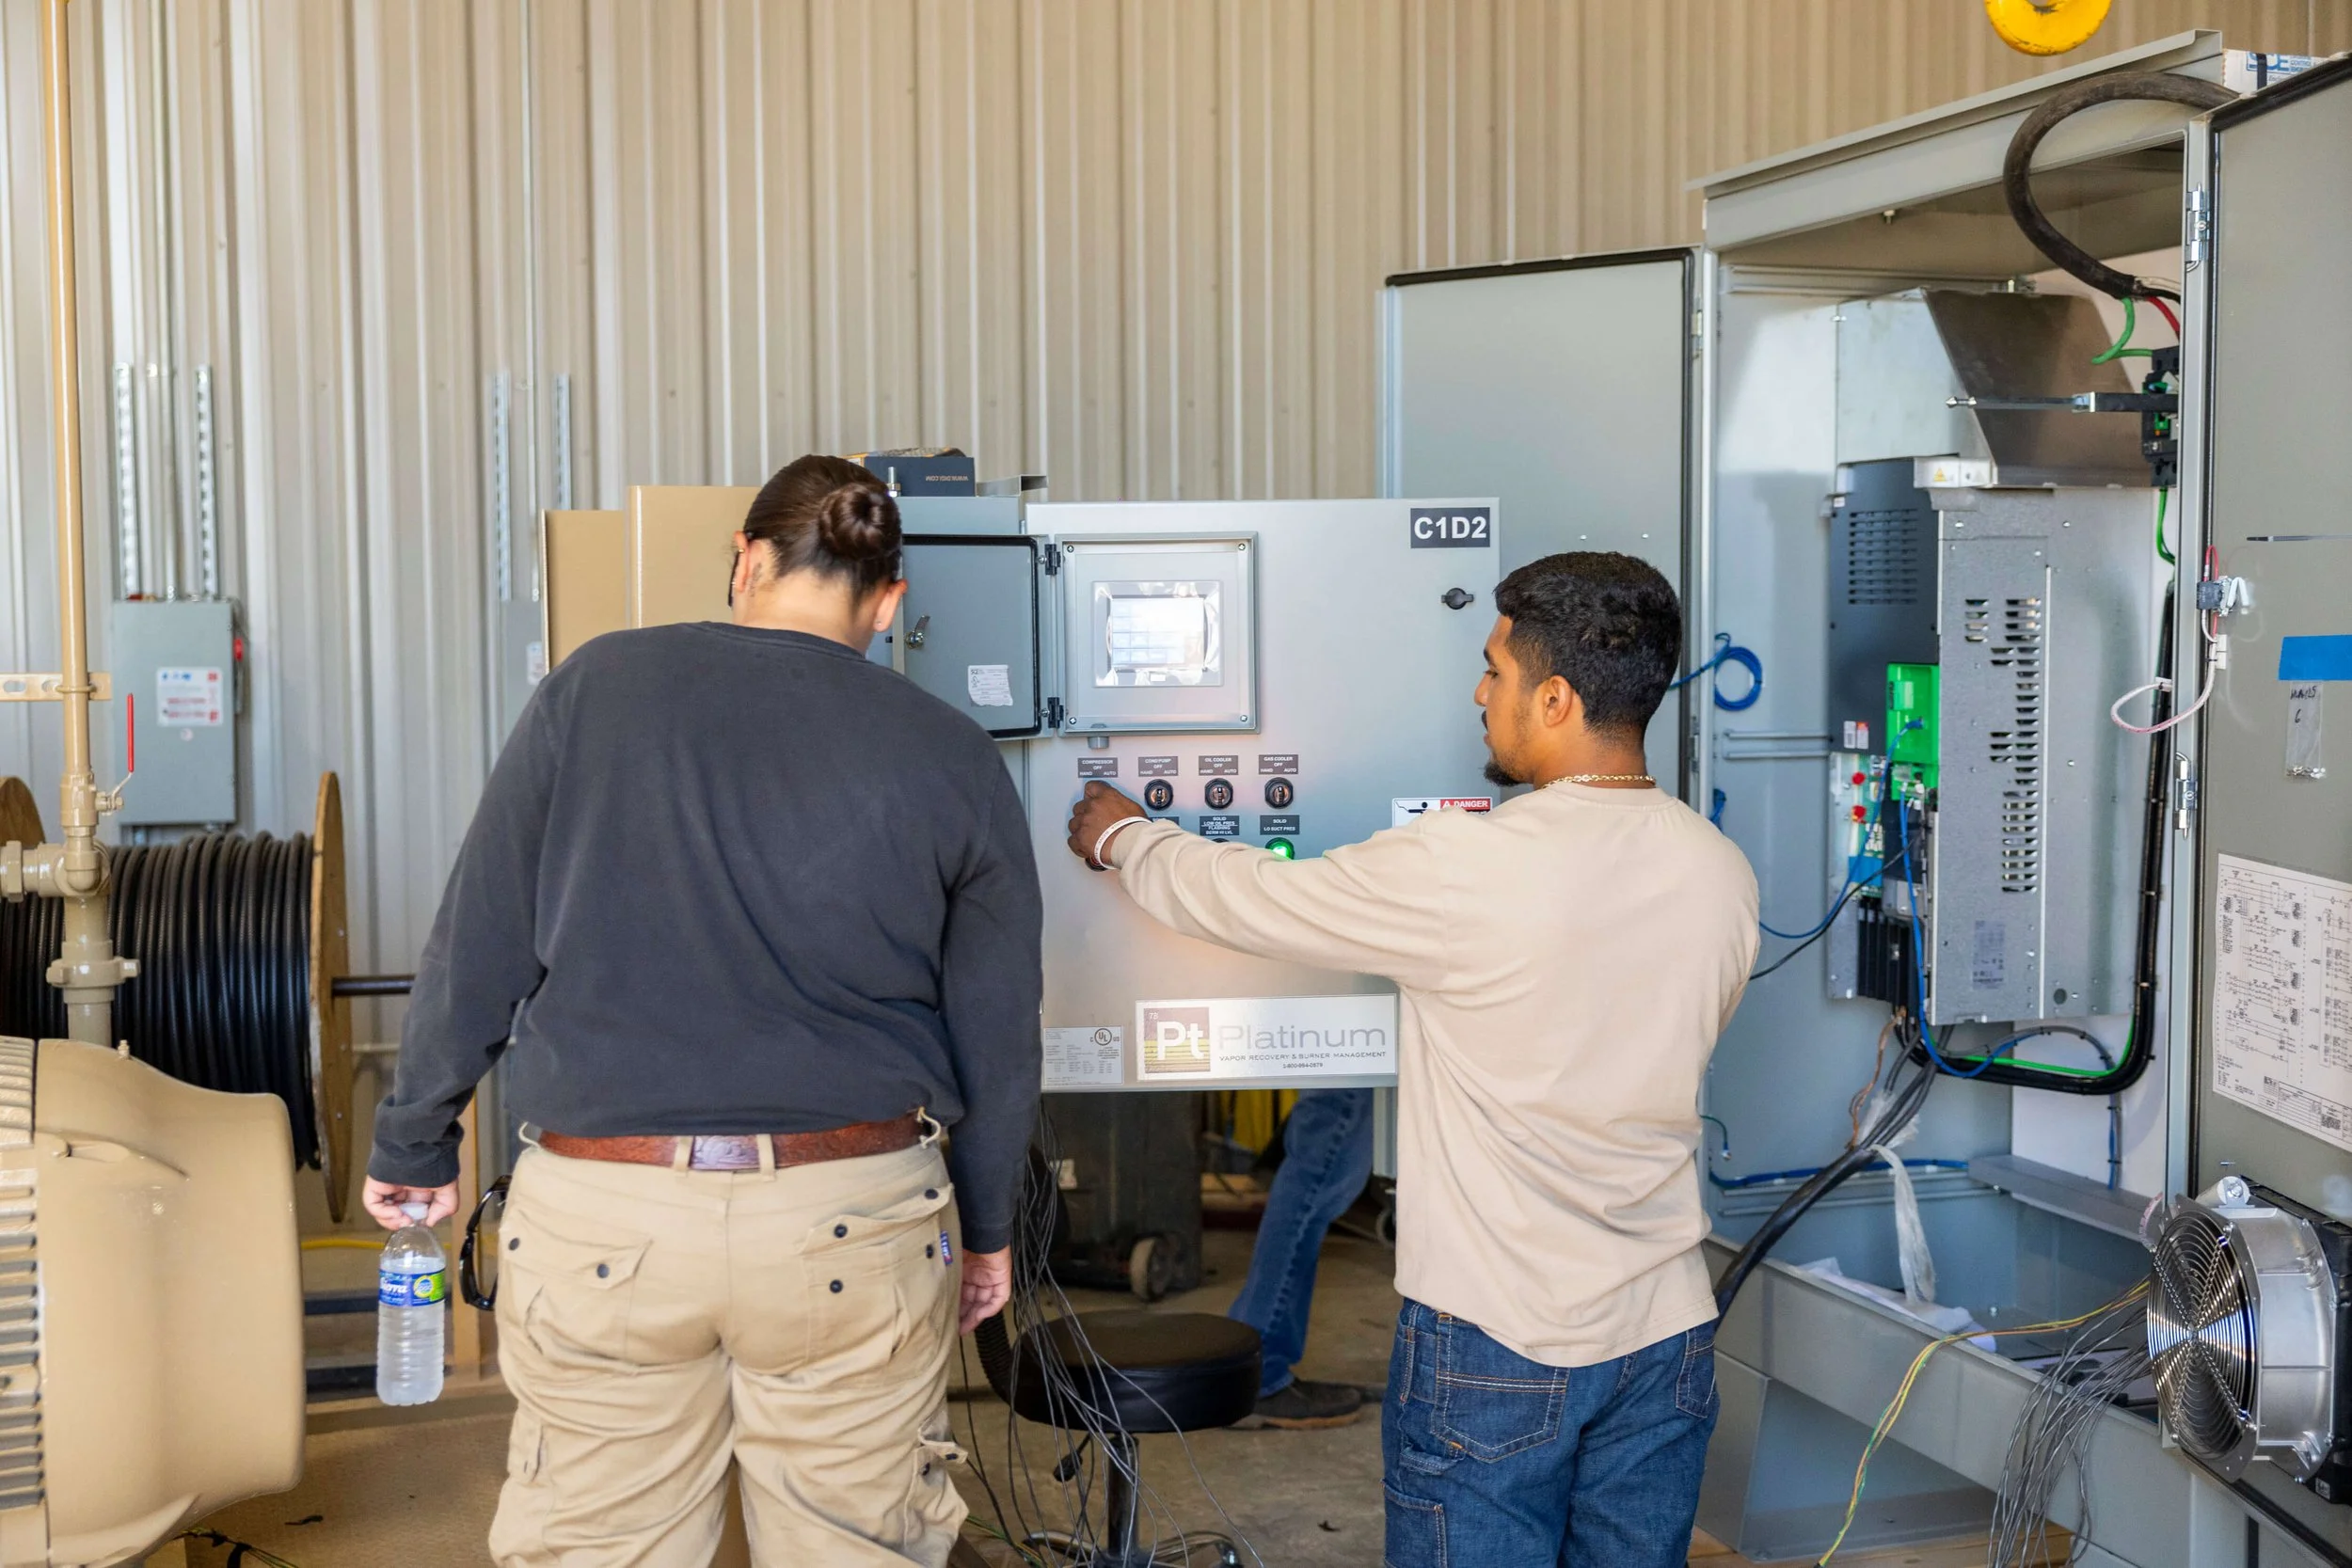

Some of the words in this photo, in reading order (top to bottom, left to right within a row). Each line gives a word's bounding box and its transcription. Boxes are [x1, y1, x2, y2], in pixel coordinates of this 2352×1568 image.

[1414, 516, 1486, 540] C1D2
[1454, 800, 1488, 809] DANGER
[1157, 1022, 1204, 1061] Pt
[1219, 1025, 1385, 1050] Platinum
